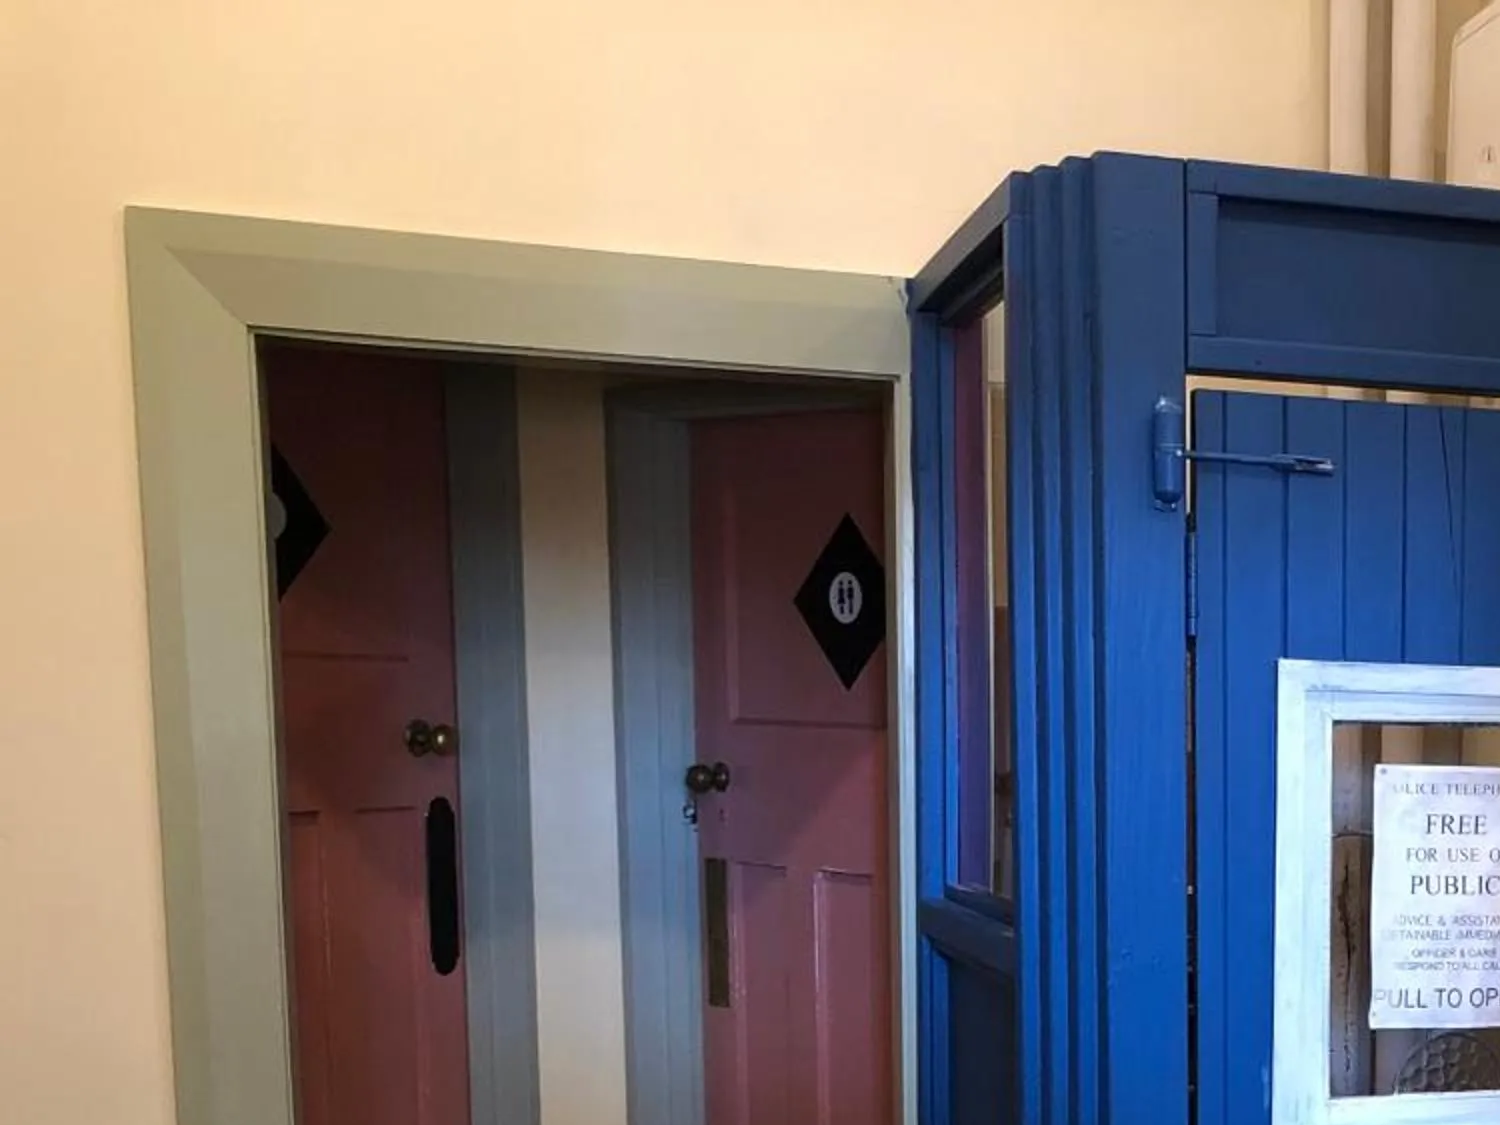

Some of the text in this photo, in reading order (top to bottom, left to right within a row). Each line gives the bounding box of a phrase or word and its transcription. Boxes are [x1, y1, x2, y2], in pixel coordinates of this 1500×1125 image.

[1389, 782, 1438, 795] OLICE
[1426, 813, 1487, 835] FREE
[1406, 847, 1438, 862] FOR
[1447, 847, 1481, 862] USE
[1411, 875, 1500, 896] PUBLIC
[1437, 914, 1447, 927] &
[1375, 988, 1428, 1008] PULL
[1434, 987, 1462, 1008] TO
